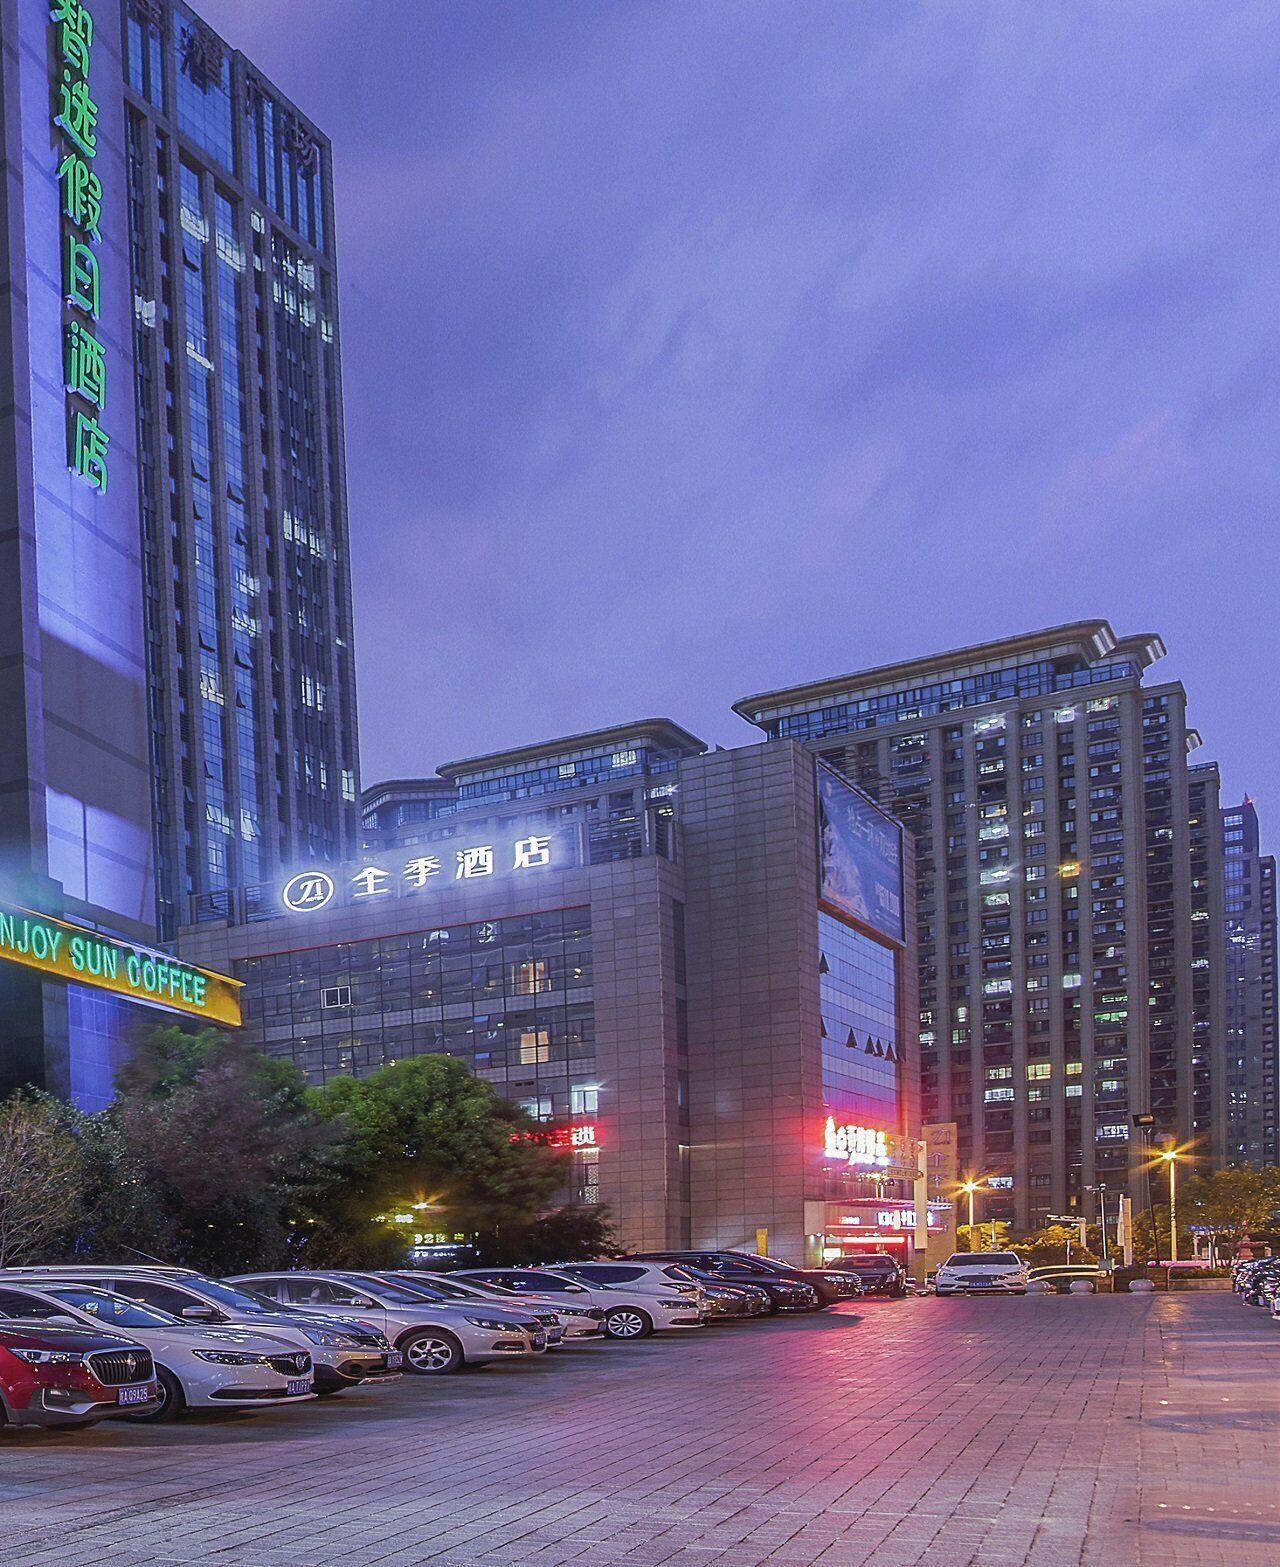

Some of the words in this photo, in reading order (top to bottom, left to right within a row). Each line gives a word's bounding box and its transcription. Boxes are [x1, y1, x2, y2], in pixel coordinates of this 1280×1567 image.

[351, 834, 553, 898] 全季酒店
[70, 937, 118, 980] SUN
[126, 954, 207, 1007] COFFEE
